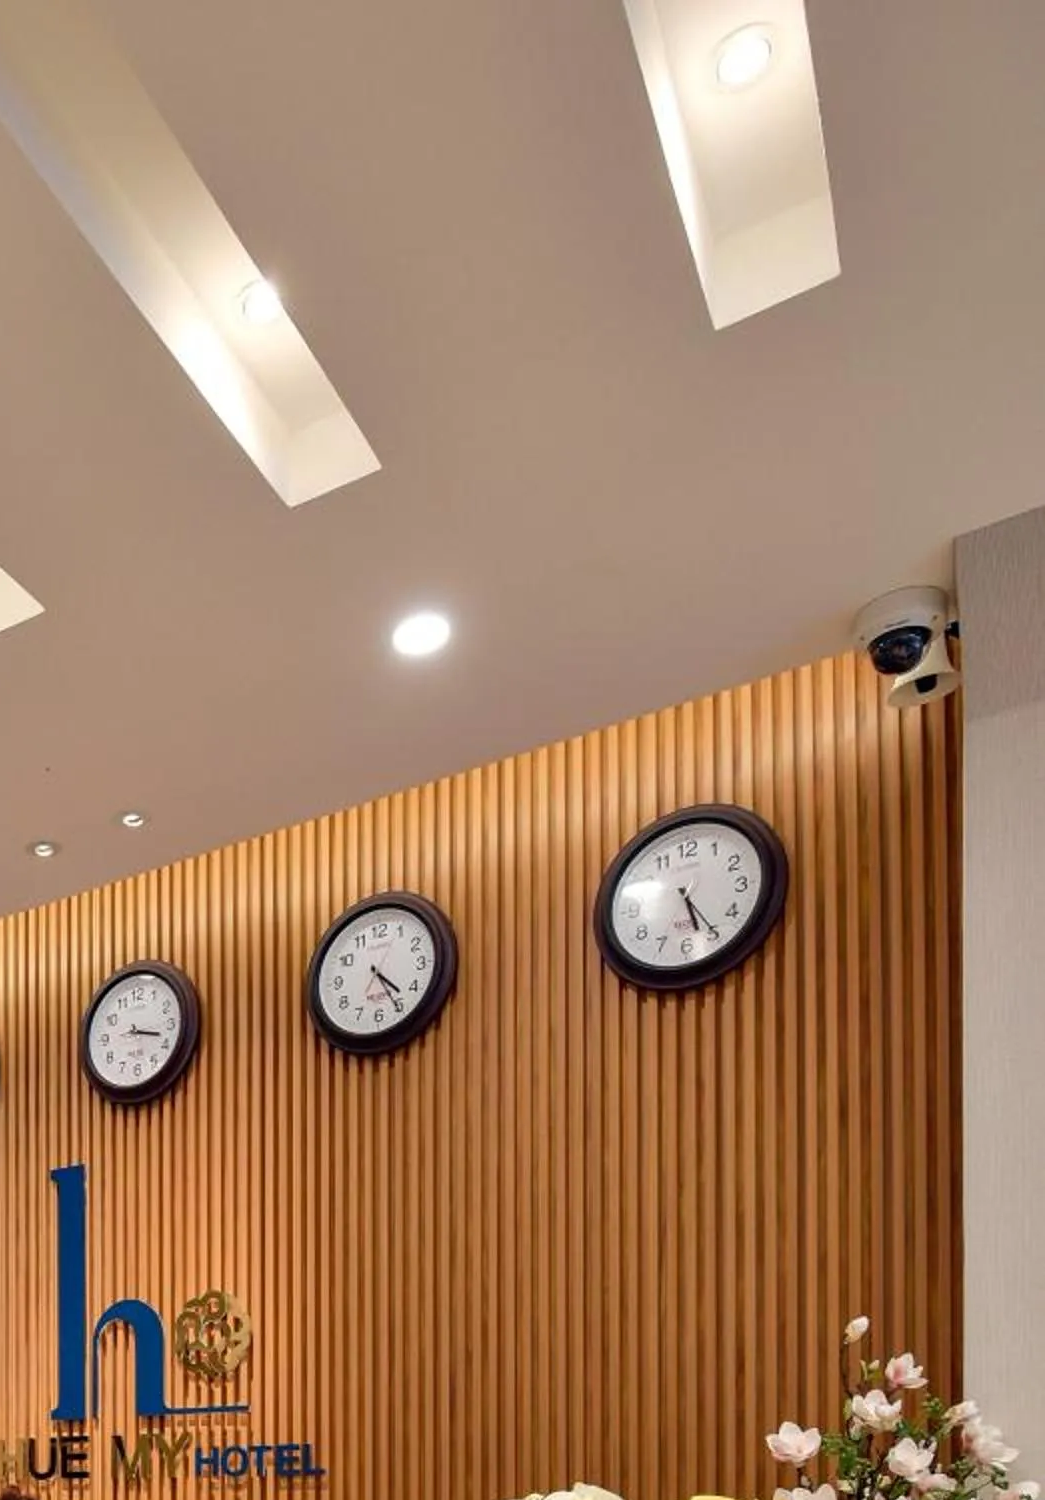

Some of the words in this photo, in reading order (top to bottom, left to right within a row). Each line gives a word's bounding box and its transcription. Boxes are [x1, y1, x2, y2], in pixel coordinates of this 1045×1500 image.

[677, 841, 697, 857] 12
[712, 842, 718, 856] 1
[657, 855, 669, 869] 11
[728, 855, 740, 871] 2
[735, 877, 747, 892] 3
[629, 903, 640, 918] 9
[726, 903, 739, 918] 4
[372, 924, 388, 938] 12
[398, 925, 403, 937] 1
[636, 926, 647, 940] 8
[708, 926, 720, 940] 5
[355, 935, 366, 948] 11
[411, 937, 421, 952] 2
[656, 936, 667, 952] 7
[681, 938, 693, 953] 6
[340, 954, 353, 966] 10
[417, 956, 426, 970] 3
[334, 976, 343, 990] 9
[409, 980, 418, 992] 4
[132, 988, 144, 1002] 12
[152, 991, 156, 1000] 1
[118, 998, 127, 1009] 11
[163, 1000, 171, 1014] 2
[339, 996, 349, 1009] 8
[355, 1008, 363, 1021] 7
[375, 1009, 384, 1022] 6
[167, 1018, 175, 1030] 3
[101, 1034, 109, 1046] 9
[161, 1039, 168, 1049] 4
[107, 1052, 113, 1064] 8
[119, 1062, 126, 1073] 7
[134, 1064, 141, 1076] 6
[111, 1432, 193, 1482] MY
[195, 1441, 326, 1477] HOTEL
